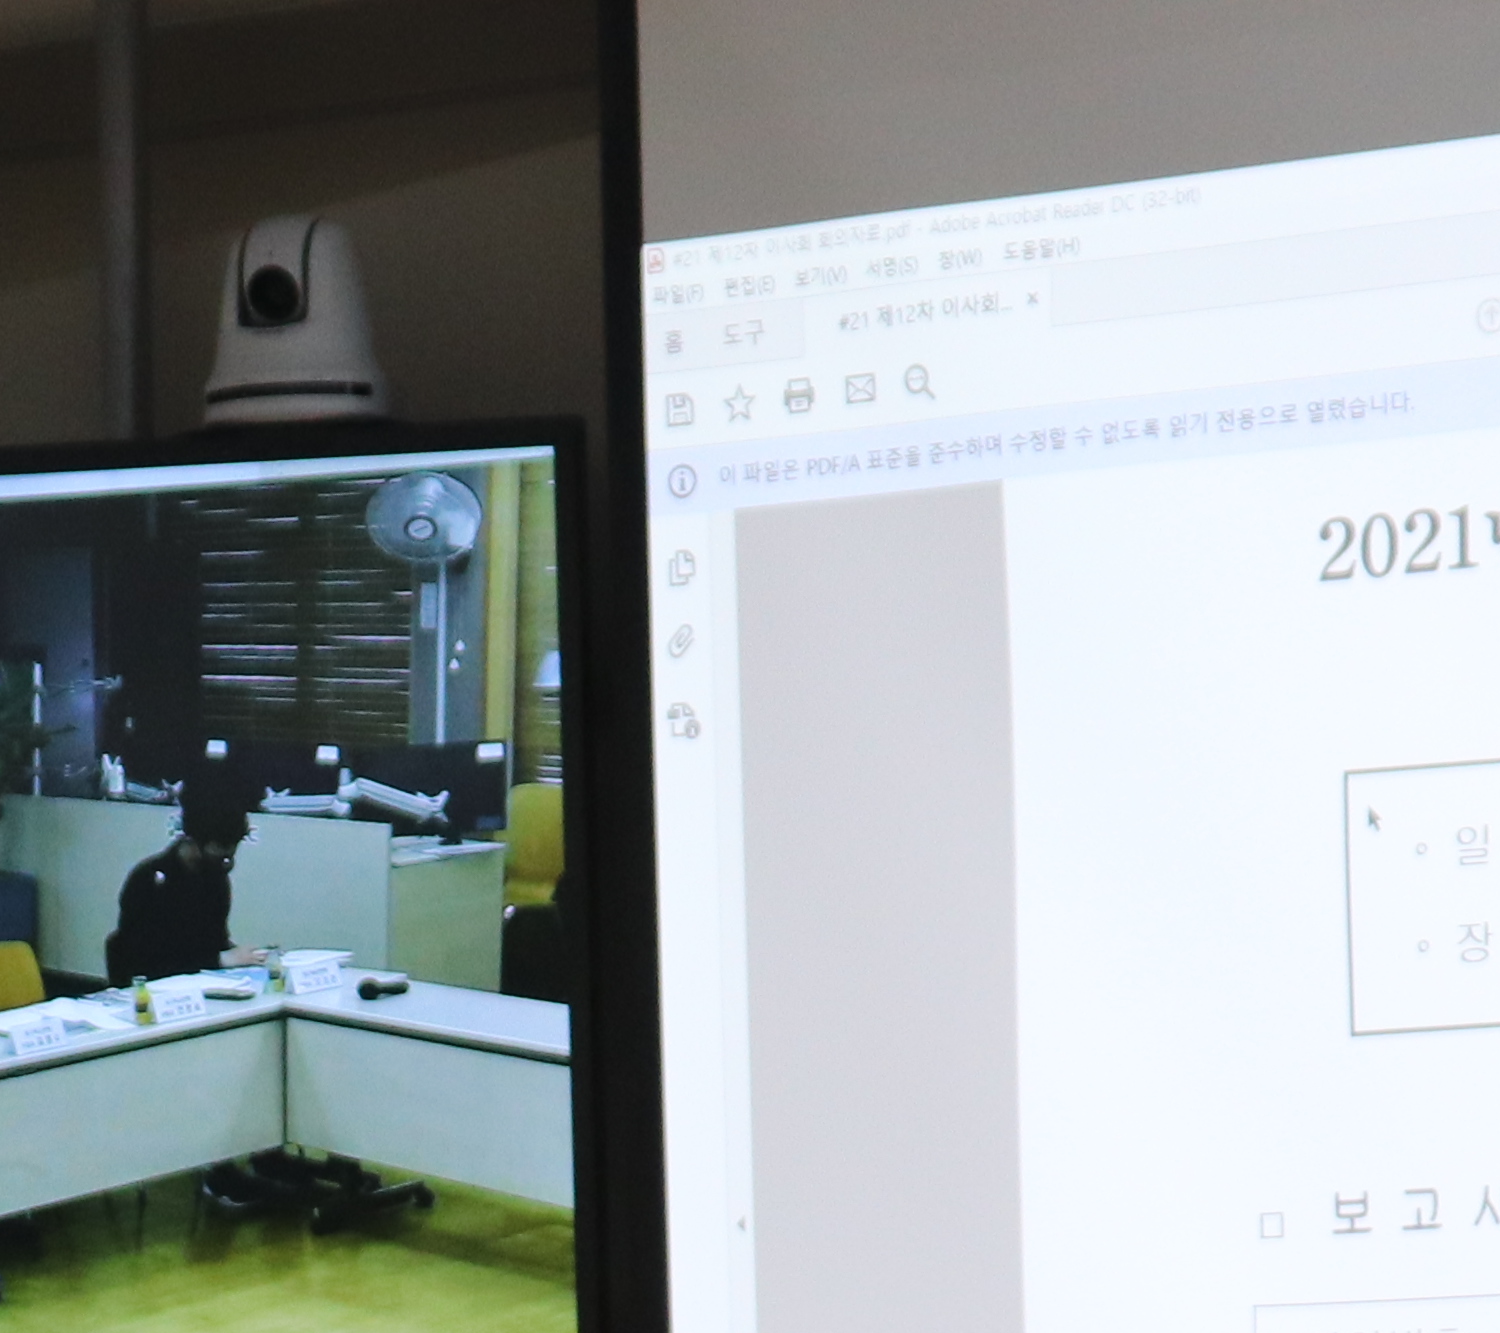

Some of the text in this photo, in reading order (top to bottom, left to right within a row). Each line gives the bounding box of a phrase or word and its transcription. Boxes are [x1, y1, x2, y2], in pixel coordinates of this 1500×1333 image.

[876, 300, 935, 327] 제12차
[722, 319, 765, 345] 도구
[743, 458, 799, 484] 파일은
[805, 453, 862, 478] PDF/A
[866, 445, 921, 472] 표준을
[928, 433, 1003, 466] 준수하며
[1009, 426, 1067, 453] 수정할
[1074, 425, 1094, 447] 수
[1101, 416, 1161, 446] 없도록
[1168, 411, 1209, 439] 읽기
[1216, 401, 1299, 435] 전용으로
